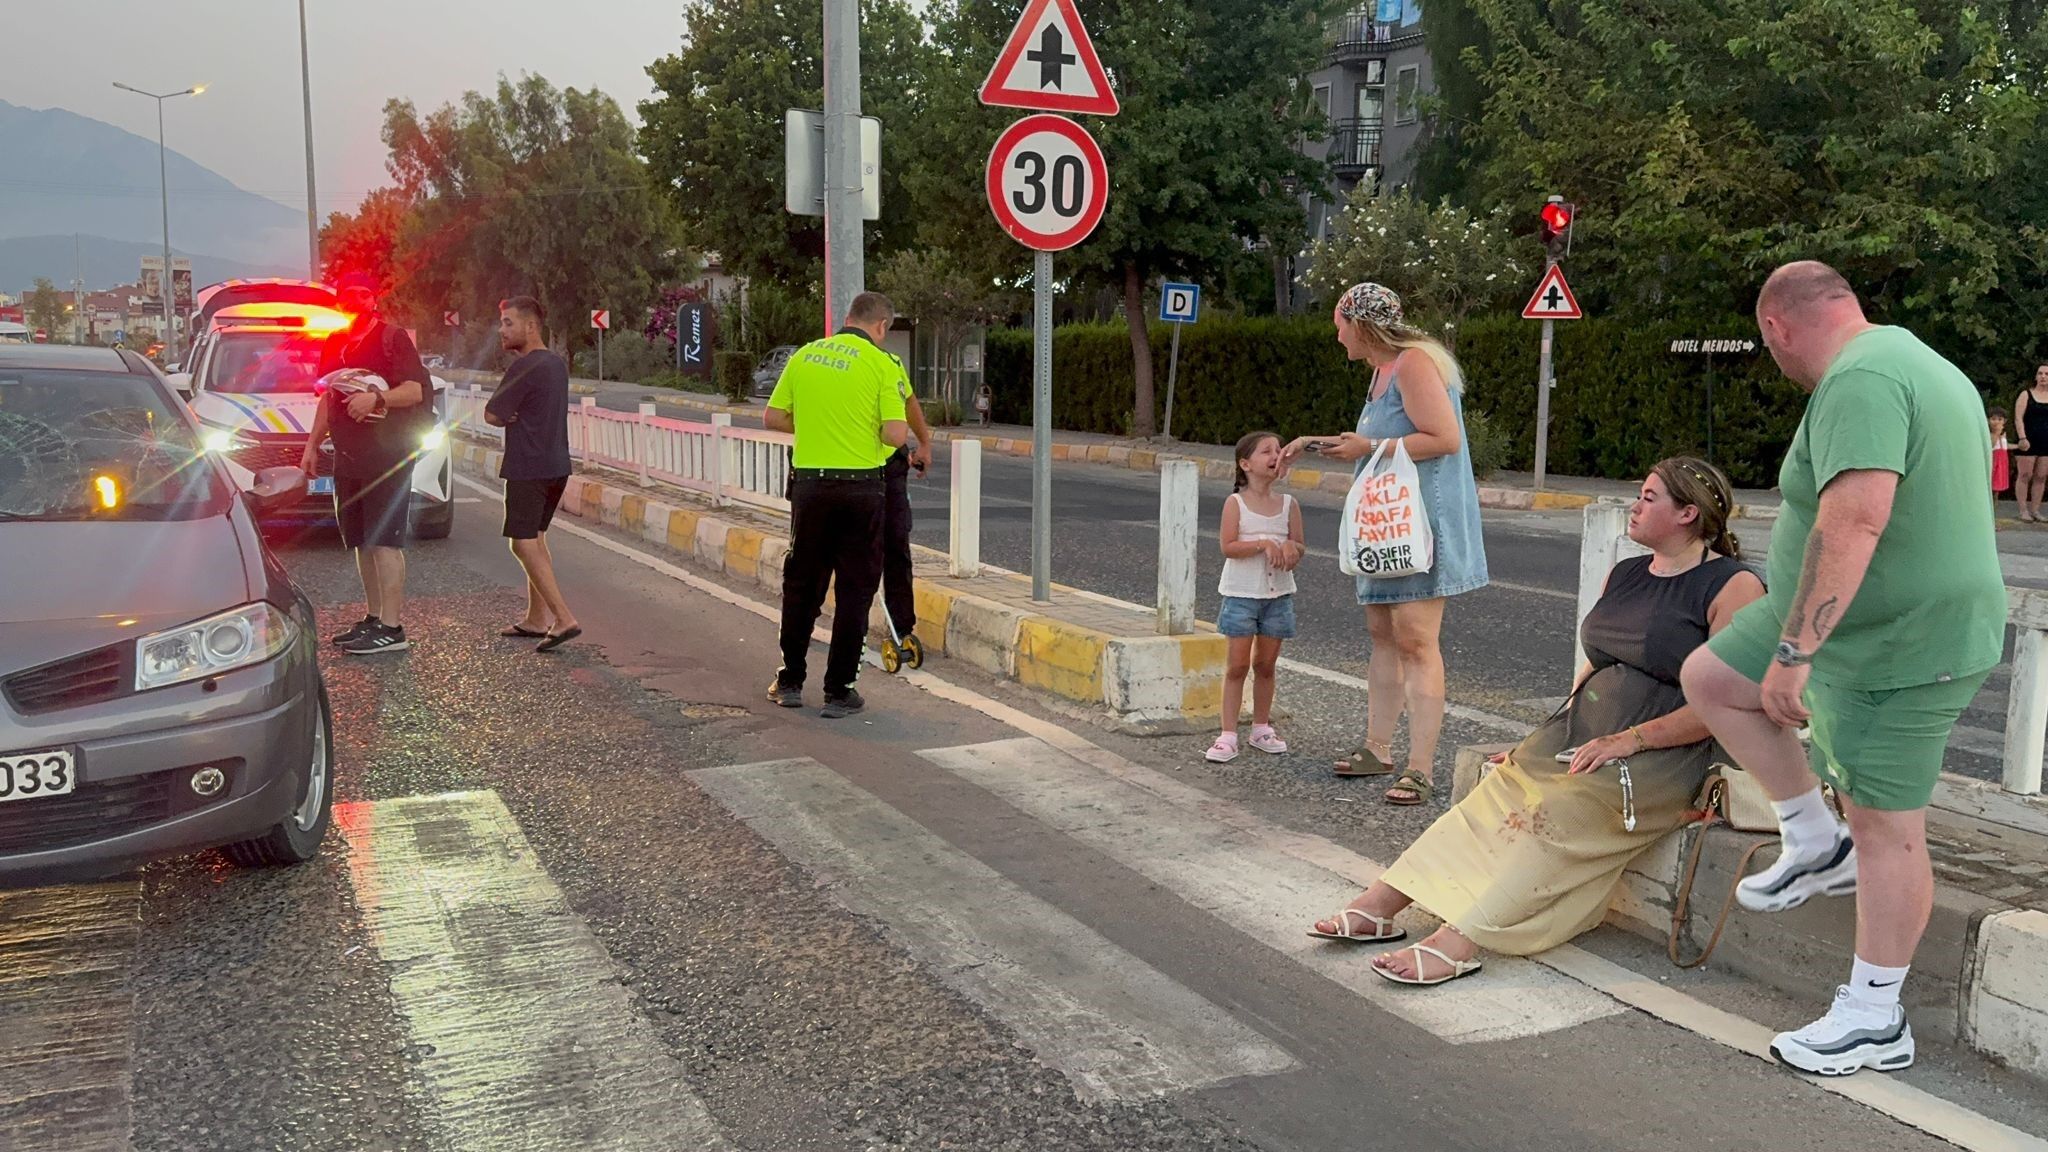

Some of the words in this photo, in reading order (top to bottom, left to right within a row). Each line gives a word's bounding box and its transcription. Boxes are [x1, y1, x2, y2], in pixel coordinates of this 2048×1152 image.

[1013, 151, 1084, 217] 30
[1173, 292, 1186, 312] D
[684, 308, 700, 362] Remer
[1670, 340, 1699, 352] HOTEL
[1701, 340, 1743, 352] MENDOS
[1379, 544, 1412, 559] SIFIR
[1382, 556, 1414, 572] ATIK
